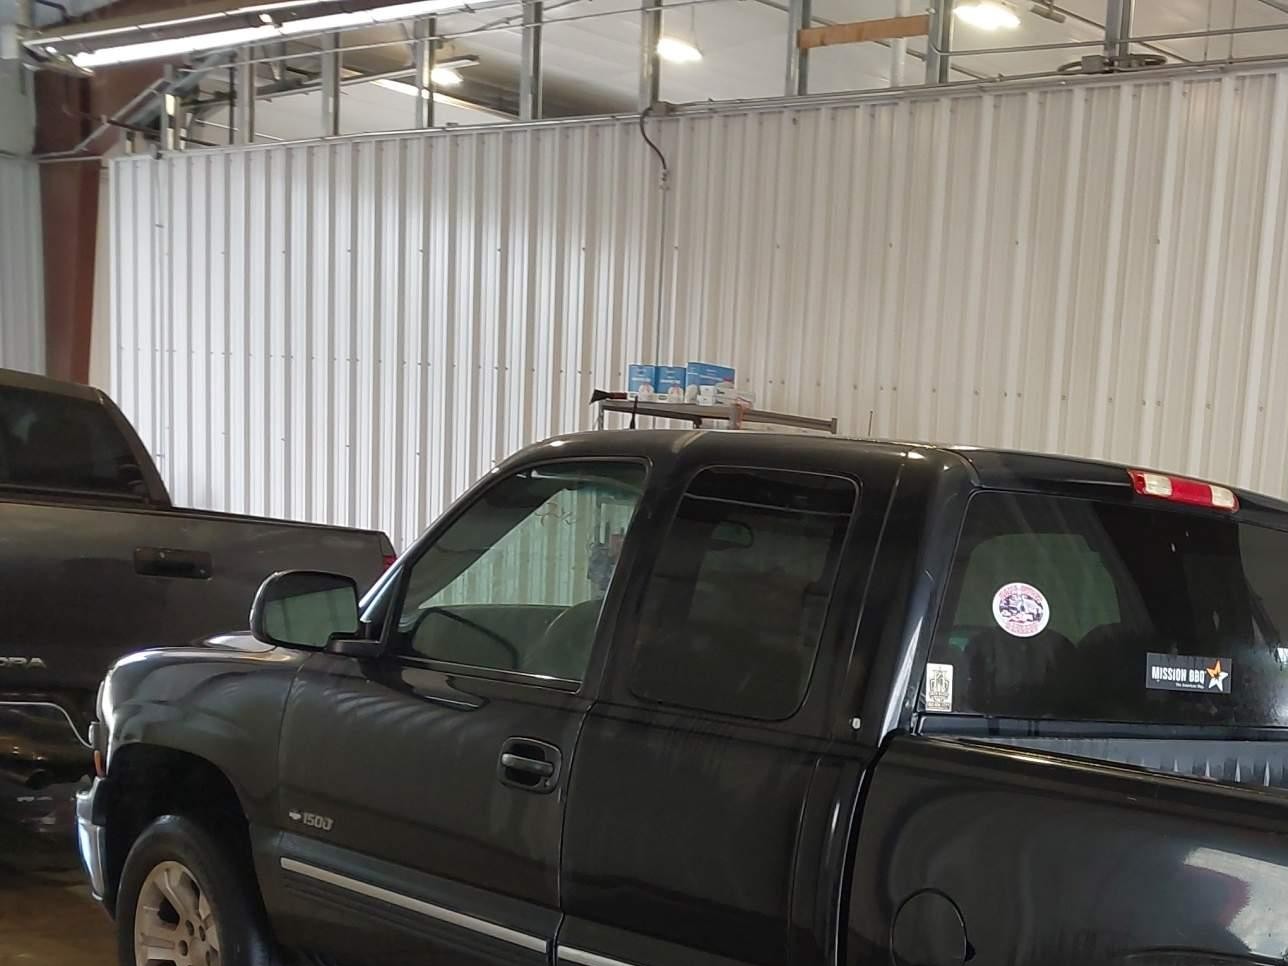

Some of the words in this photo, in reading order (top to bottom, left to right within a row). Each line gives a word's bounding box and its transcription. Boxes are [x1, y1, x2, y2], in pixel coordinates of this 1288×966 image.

[1151, 666, 1188, 682] MISSION
[1189, 669, 1205, 684] BBQ
[303, 812, 334, 831] 1500
